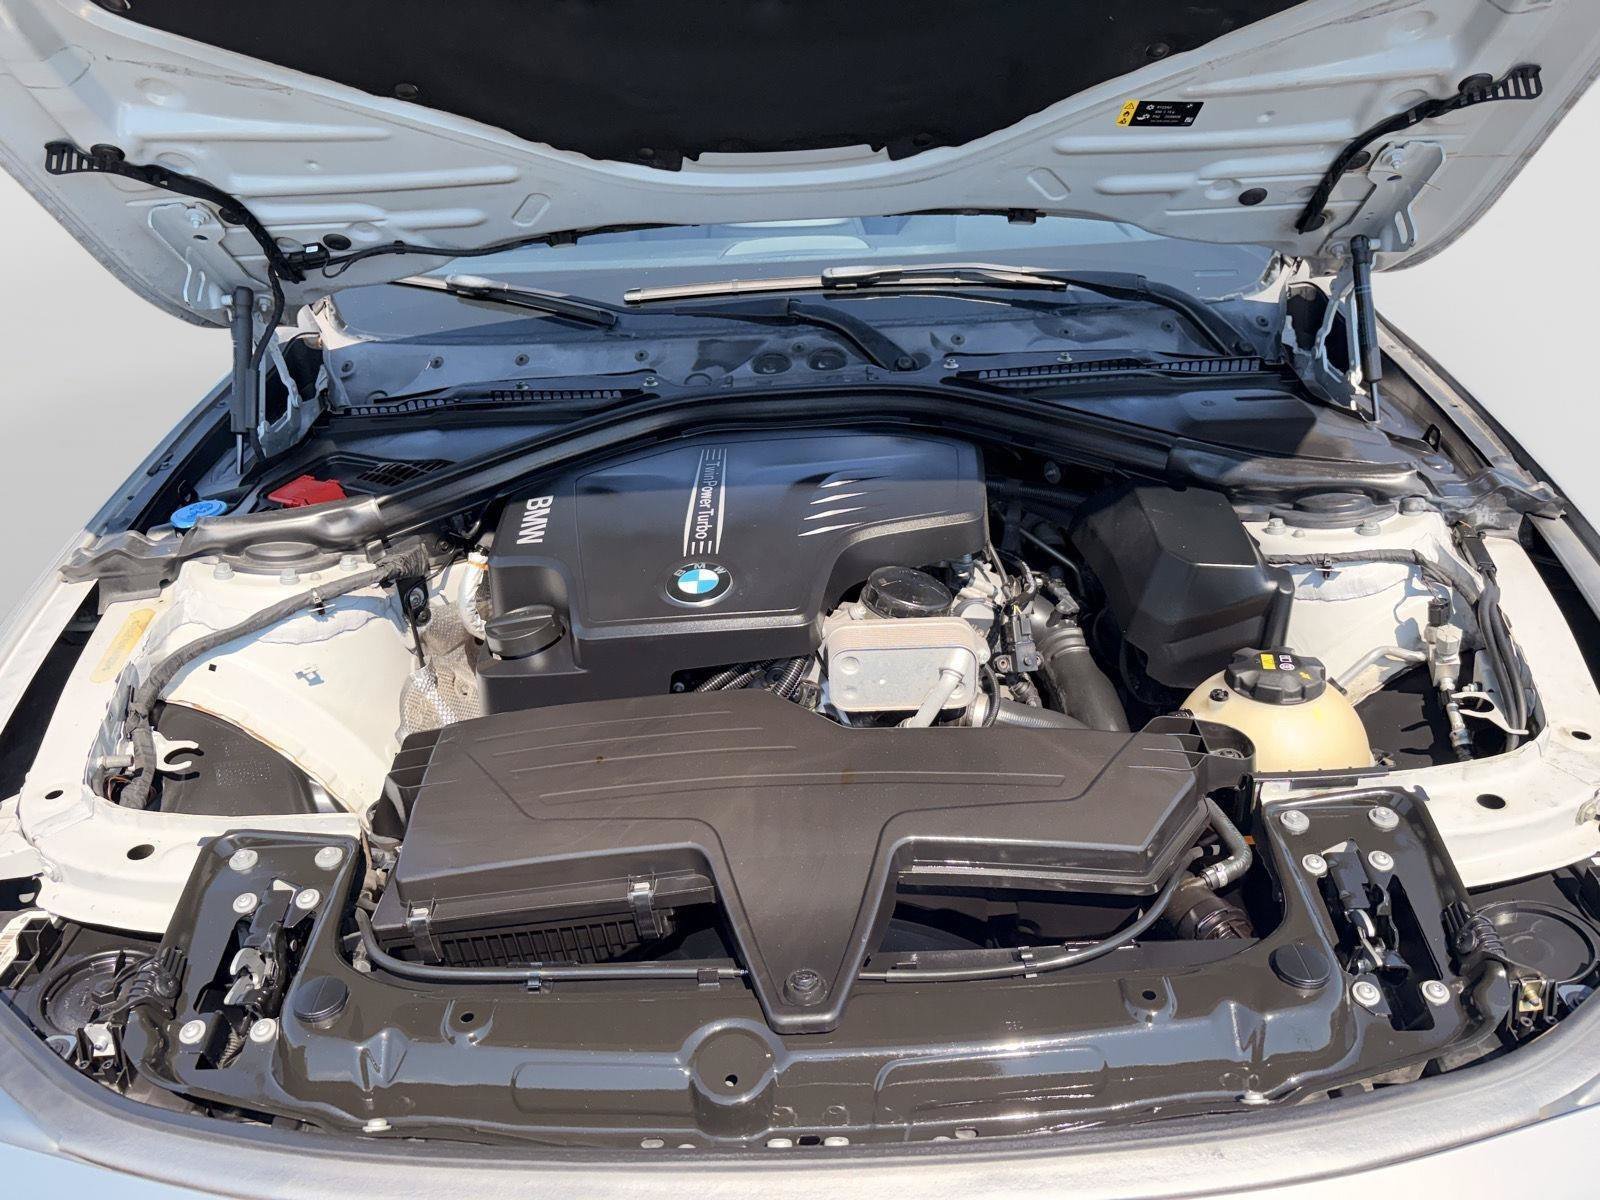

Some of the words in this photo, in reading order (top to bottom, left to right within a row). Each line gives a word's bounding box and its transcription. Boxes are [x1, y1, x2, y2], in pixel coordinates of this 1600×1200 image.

[516, 495, 554, 544] BMW
[694, 508, 715, 540] Turbo
[673, 562, 727, 577] BMW
